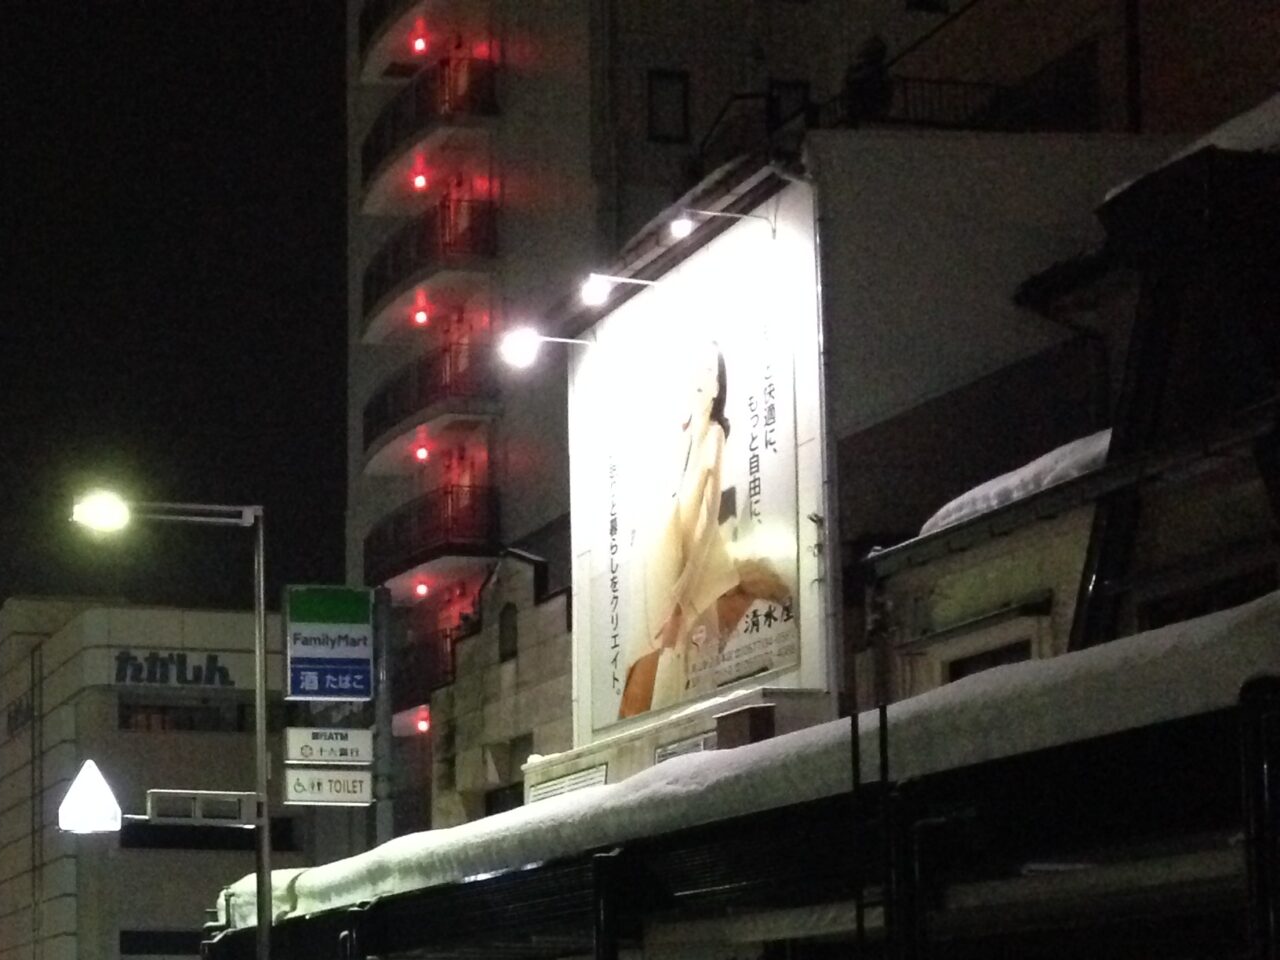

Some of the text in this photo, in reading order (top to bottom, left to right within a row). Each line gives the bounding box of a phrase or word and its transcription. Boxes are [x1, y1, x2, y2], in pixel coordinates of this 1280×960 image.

[747, 395, 763, 525] もっと自由に、
[292, 633, 369, 649] FamilyMart
[300, 671, 364, 690] 酒 たばこ
[328, 779, 365, 794] TOILET
